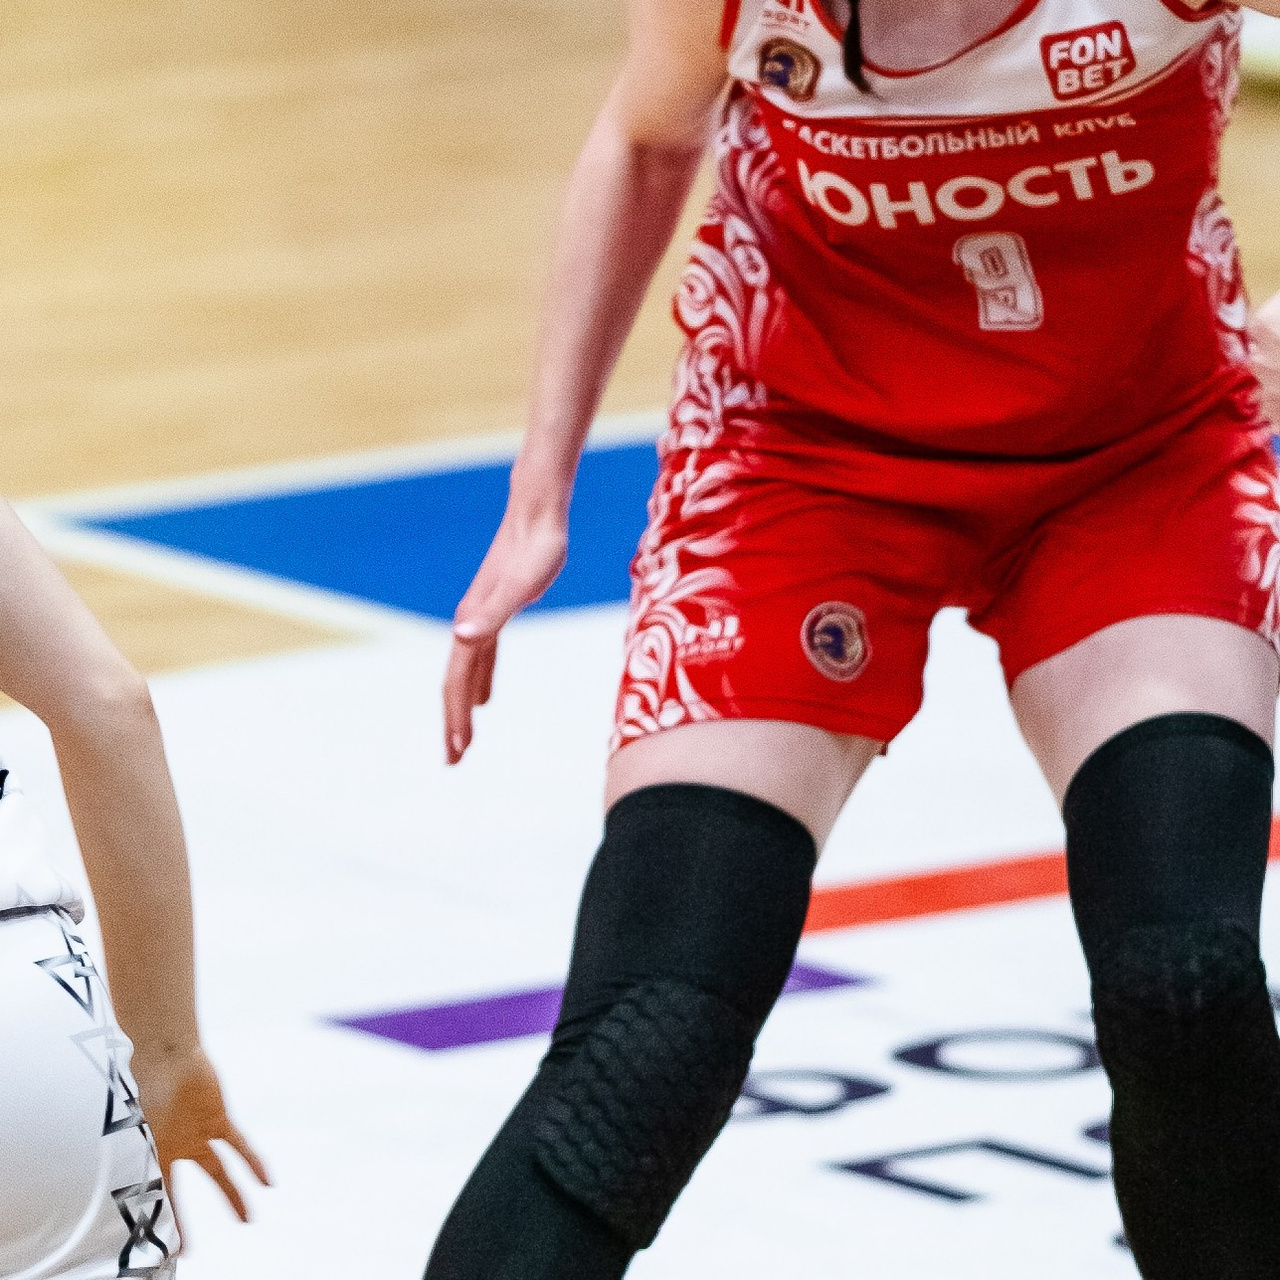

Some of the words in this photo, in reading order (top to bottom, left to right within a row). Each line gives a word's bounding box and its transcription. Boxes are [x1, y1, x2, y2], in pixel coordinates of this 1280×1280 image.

[1048, 28, 1122, 70] FON
[1057, 58, 1128, 95] BET
[783, 119, 1041, 160] АСКЕТБОЛЬНЫЙ
[797, 150, 1155, 229] ЮНОСТЬ
[952, 231, 1044, 332] 9
